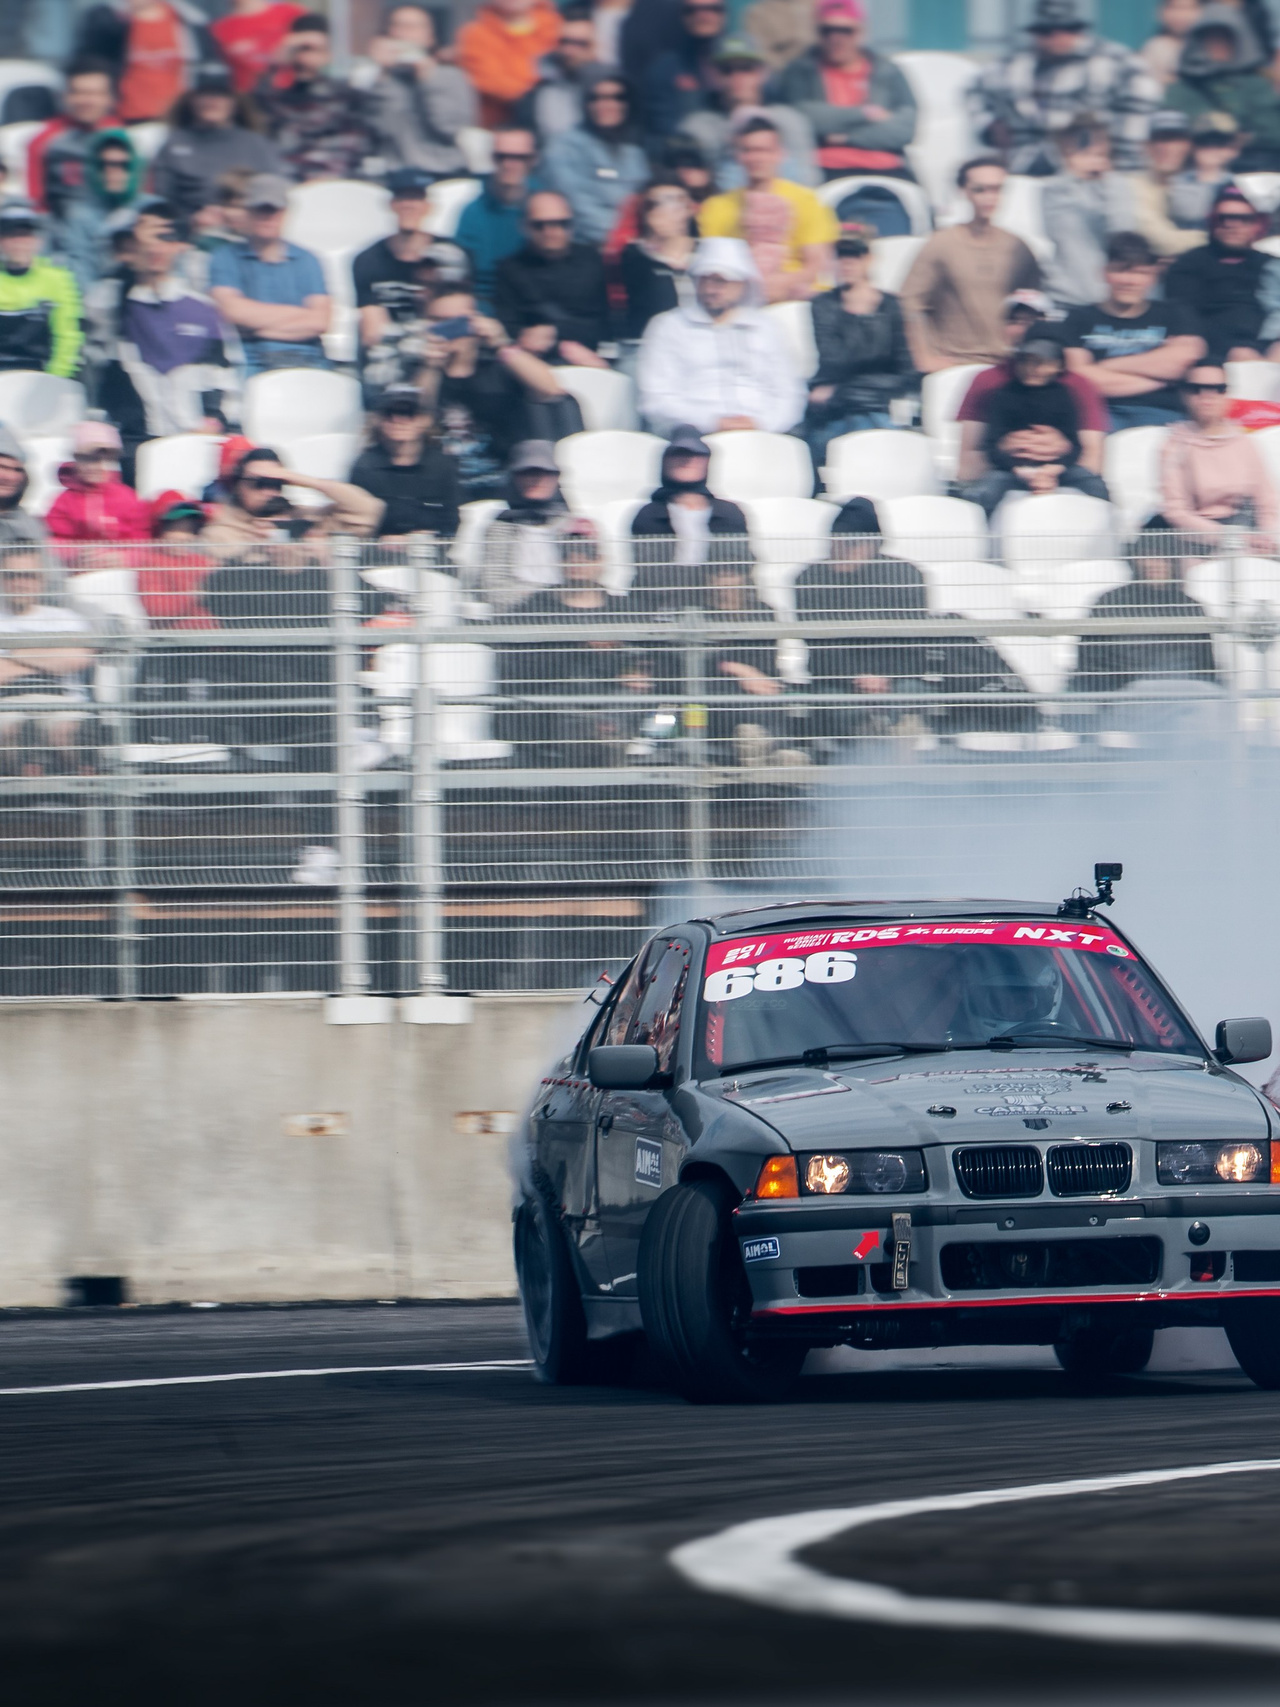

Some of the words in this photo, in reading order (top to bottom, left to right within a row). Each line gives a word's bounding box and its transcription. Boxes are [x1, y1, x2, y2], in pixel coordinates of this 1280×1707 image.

[829, 927, 903, 945] RDS
[1013, 926, 1104, 945] NXT
[703, 950, 858, 1003] 686
[636, 1148, 660, 1176] AIMOL
[745, 1241, 777, 1258] AIMOL
